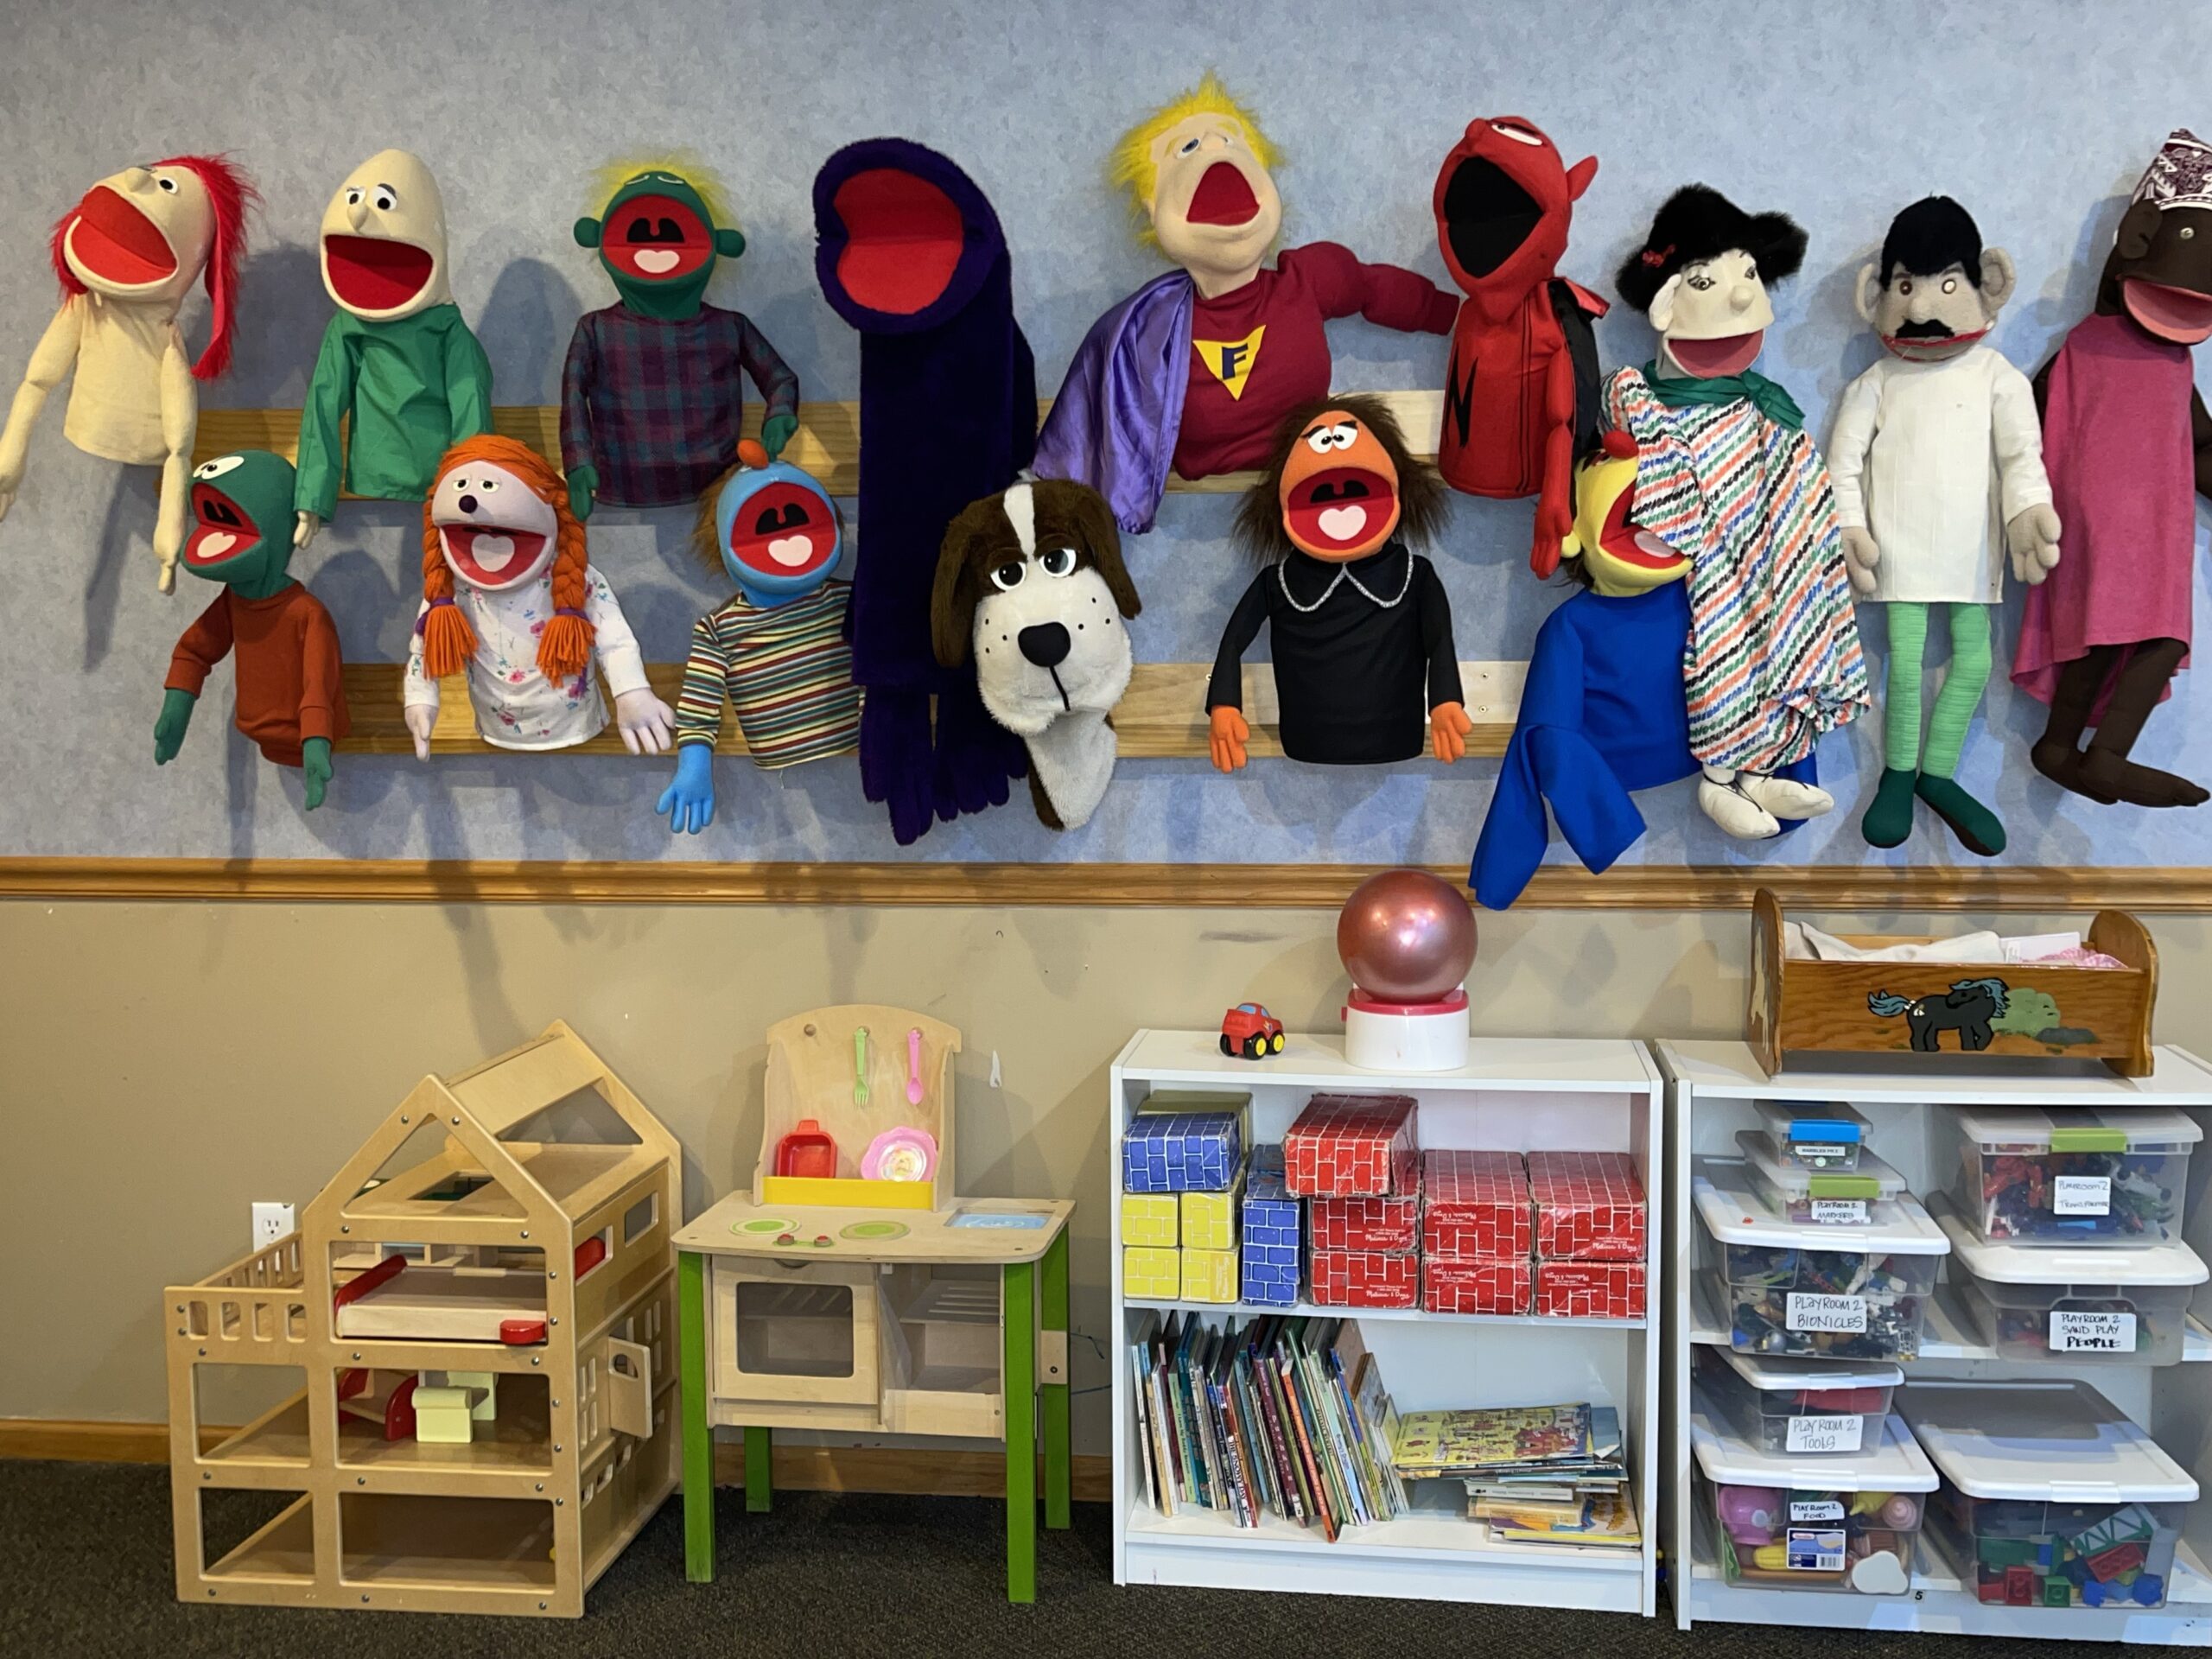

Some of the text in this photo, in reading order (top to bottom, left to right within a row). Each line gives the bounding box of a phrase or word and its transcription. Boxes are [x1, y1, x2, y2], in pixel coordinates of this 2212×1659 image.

[1222, 343, 1249, 380] F
[1853, 1300, 1863, 1311] 2
[1797, 1313, 1863, 1329] BIONICLES
[2113, 1315, 2120, 1324] 2
[2062, 1325, 2120, 1335] SAND PLAY
[2067, 1336, 2121, 1348] PEOPLE
[1847, 1419, 1857, 1431] 2
[1231, 1454, 1244, 1483] SNOWY
[1915, 1590, 1923, 1600] 5
